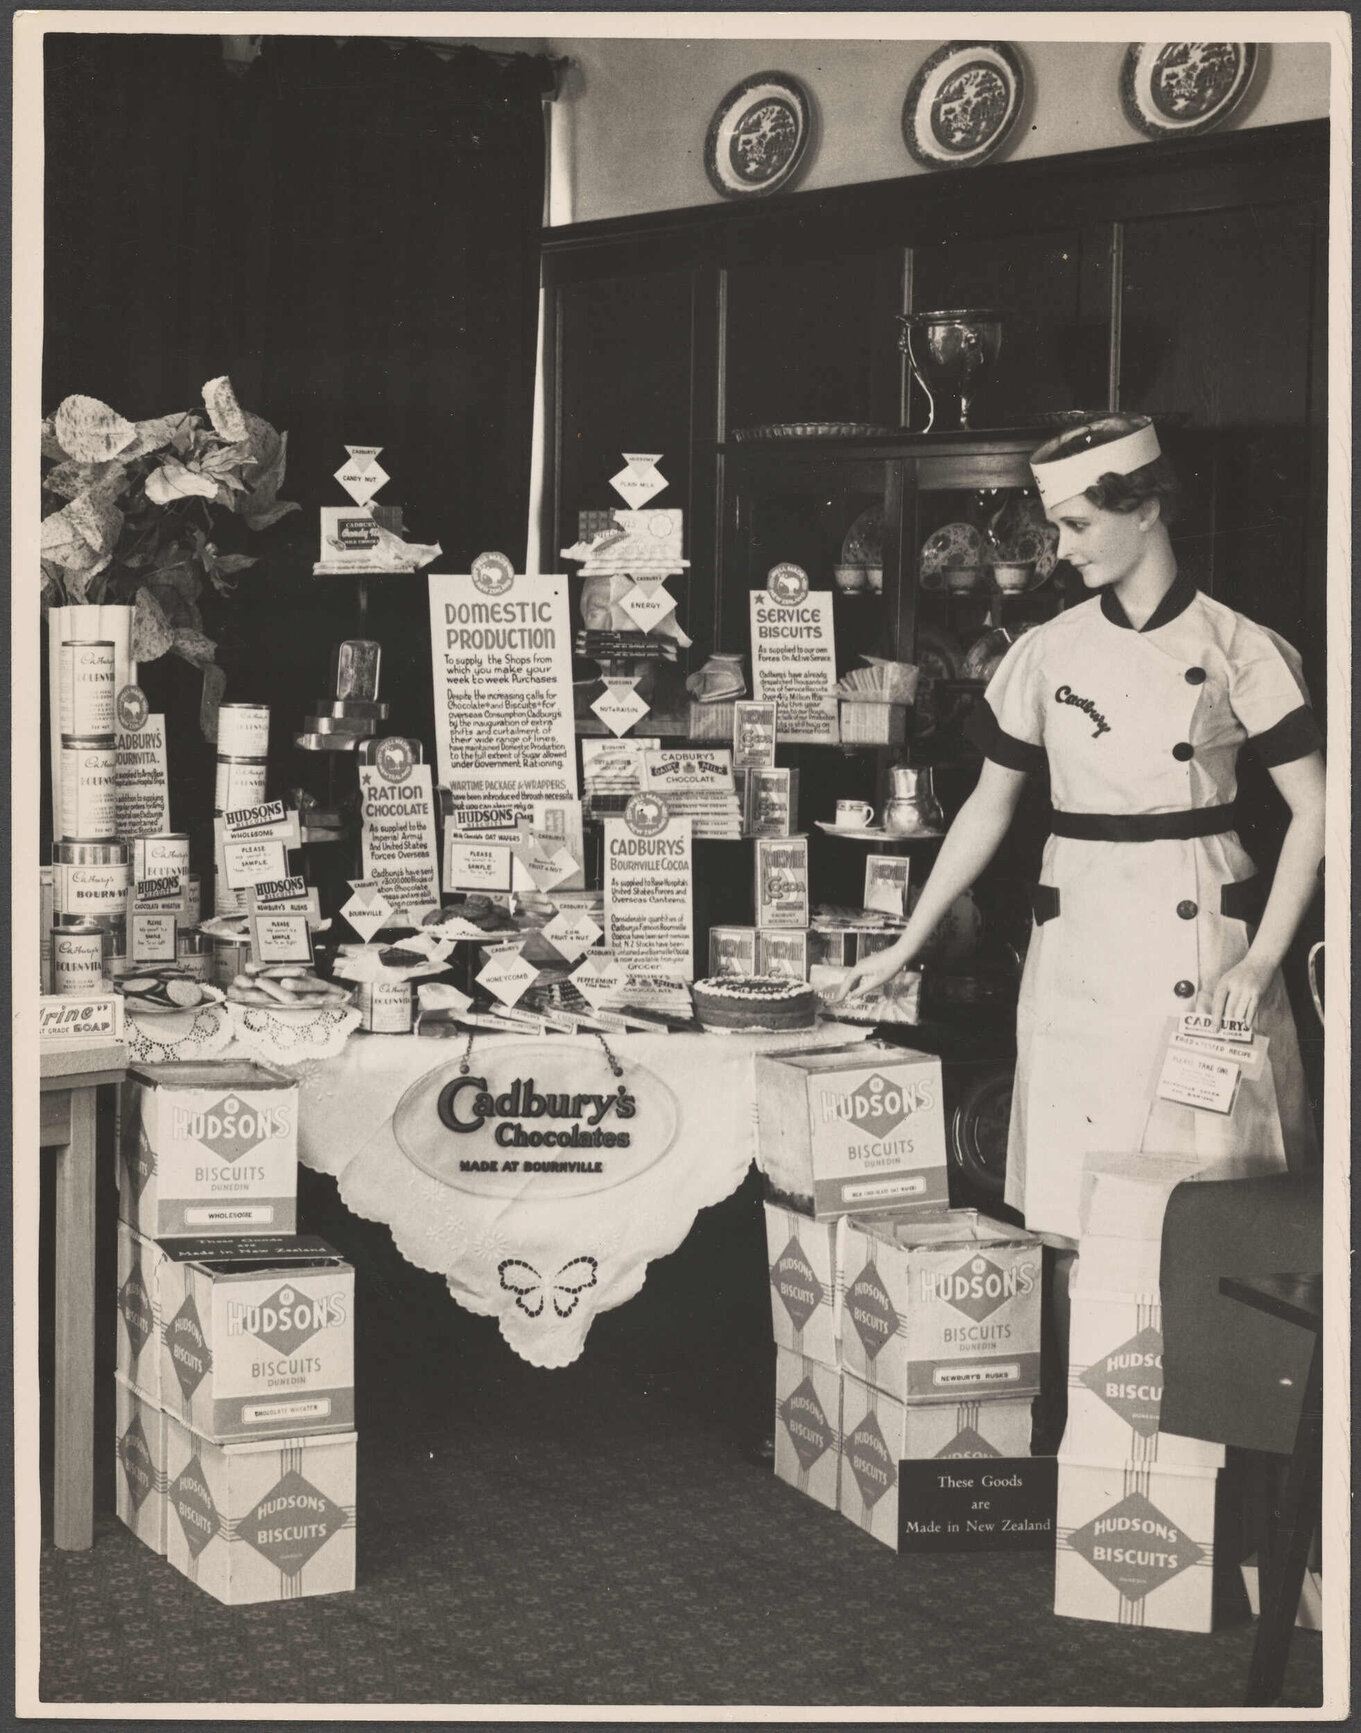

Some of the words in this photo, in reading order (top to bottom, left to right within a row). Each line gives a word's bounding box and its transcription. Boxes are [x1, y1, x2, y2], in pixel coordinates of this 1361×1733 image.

[630, 602, 661, 610] ENERGY
[445, 602, 552, 624] DOMESTIC
[756, 608, 821, 624] SERVICE
[446, 628, 556, 650] PRODUCTION
[758, 626, 822, 640] BISCUITS
[758, 644, 766, 654] As
[768, 644, 796, 655] supplied
[444, 654, 454, 664] To
[456, 654, 482, 666] supply
[488, 654, 502, 664] the
[505, 654, 531, 666] Shops
[533, 653, 552, 664] from
[758, 654, 780, 662] Forces
[791, 654, 810, 662] Active
[446, 665, 471, 674] which
[474, 668, 492, 676] you
[494, 666, 523, 674] make
[526, 666, 552, 676] your
[446, 675, 470, 684] week
[472, 675, 484, 684] to
[485, 675, 510, 684] week
[512, 674, 558, 684] Purchases
[448, 689, 472, 702] Despite
[474, 690, 486, 700] the
[487, 692, 524, 702] increasing
[526, 690, 544, 700] calls
[546, 689, 557, 700] for
[542, 700, 556, 709] for
[450, 728, 473, 736] shifts
[476, 728, 492, 736] and
[493, 727, 539, 736] curtailment
[542, 726, 552, 736] of
[450, 736, 471, 744] their
[474, 735, 494, 743] wide
[496, 736, 520, 745] range
[522, 734, 532, 743] of
[500, 743, 529, 752] Domestic
[530, 743, 566, 751] Production
[450, 752, 459, 760] to
[461, 751, 474, 760] the
[474, 750, 486, 760] full
[488, 751, 512, 759] extent
[522, 750, 540, 760] Sugar
[542, 750, 567, 759] allowed
[661, 752, 715, 761] CADBURY'S
[451, 760, 474, 769] under
[474, 758, 521, 769] Government
[450, 780, 484, 792] WARTIME
[485, 780, 516, 791] PACKAGE
[524, 779, 566, 790] WRAPPERS
[666, 776, 715, 784] CHOCOLATE
[368, 785, 422, 801] RATION
[482, 790, 520, 801] introduced
[226, 802, 282, 825] HUDSONS
[366, 803, 428, 817] CHOCOLATE
[458, 809, 513, 824] HUDSONS
[370, 823, 378, 832] As
[380, 821, 408, 833] supplied
[408, 821, 416, 831] to
[416, 820, 427, 831] the
[231, 830, 274, 840] WHOLESOME
[372, 832, 399, 842] Imperial
[402, 832, 423, 842] Army
[498, 834, 520, 842] WAFERS
[370, 842, 381, 851] And
[382, 842, 403, 850] United
[404, 841, 428, 850] States
[371, 851, 396, 860] Forces
[398, 850, 430, 859] Overseas
[470, 850, 492, 858] PLEASE
[406, 866, 419, 876] have
[420, 866, 434, 875] sent
[610, 858, 660, 871] BOURNVILLE
[660, 858, 689, 871] COCOA
[138, 876, 180, 896] HUDSONS
[256, 878, 304, 896] HUDSONS
[620, 877, 643, 888] supplied
[611, 887, 631, 896] United
[633, 887, 654, 896] States
[675, 887, 687, 896] and
[611, 896, 648, 904] Overseas
[257, 904, 286, 912] NEWBURY'S
[486, 972, 528, 984] HONEYCOMB
[576, 976, 618, 985] PEPPERMINT
[73, 1022, 110, 1033] SOAP
[1229, 1048, 1251, 1058] RECIPE
[437, 1076, 636, 1133] Cadbury's
[820, 1080, 935, 1122] HUDSONS
[172, 1104, 291, 1141] HUDSONS
[495, 1122, 630, 1148] Chocolates
[848, 1139, 914, 1160] BISCUITS
[460, 1160, 498, 1172] MADE
[502, 1160, 520, 1172] AT
[524, 1160, 602, 1173] BOURNVILLE
[864, 1158, 902, 1168] DUNEDIN
[195, 1166, 266, 1182] BISCUITS
[211, 1183, 250, 1192] DUNEDIN
[208, 1212, 252, 1220] WHOLESOME
[779, 1256, 814, 1282] HUDSONS
[920, 1263, 1036, 1302] HUDSONS
[780, 1282, 815, 1305] BISCUITS
[854, 1280, 890, 1311] HUDSONS
[227, 1290, 346, 1336] HUDSONS
[854, 1308, 889, 1335] BISCUITS
[174, 1316, 202, 1348] HUDSONS
[944, 1324, 1012, 1343] BISCUITS
[960, 1342, 997, 1352] DUNEDIN
[174, 1344, 202, 1374] BISCUITS
[252, 1358, 322, 1378] BISCUITS
[267, 1376, 306, 1388] DUNEDIN
[940, 1374, 981, 1382] NEWBURY'S
[985, 1372, 1009, 1380] RUSKS
[790, 1398, 825, 1426] HUDSONS
[789, 1418, 825, 1449] BISCUITS
[854, 1430, 889, 1463] HUDSONS
[853, 1456, 889, 1486] BISCUITS
[937, 1476, 975, 1488] These
[982, 1476, 1023, 1488] Goods
[180, 1476, 212, 1509] HUDSONS
[257, 1495, 326, 1520] HUDSONS
[971, 1500, 990, 1510] are
[180, 1501, 212, 1534] BISCUITS
[906, 1520, 942, 1534] Made
[948, 1520, 960, 1532] in
[966, 1520, 996, 1532] New
[1002, 1518, 1052, 1532] Zealand
[1094, 1518, 1178, 1544] HUDSONS
[257, 1524, 328, 1545] BISCUITS
[1093, 1547, 1178, 1569] BISCUITS
